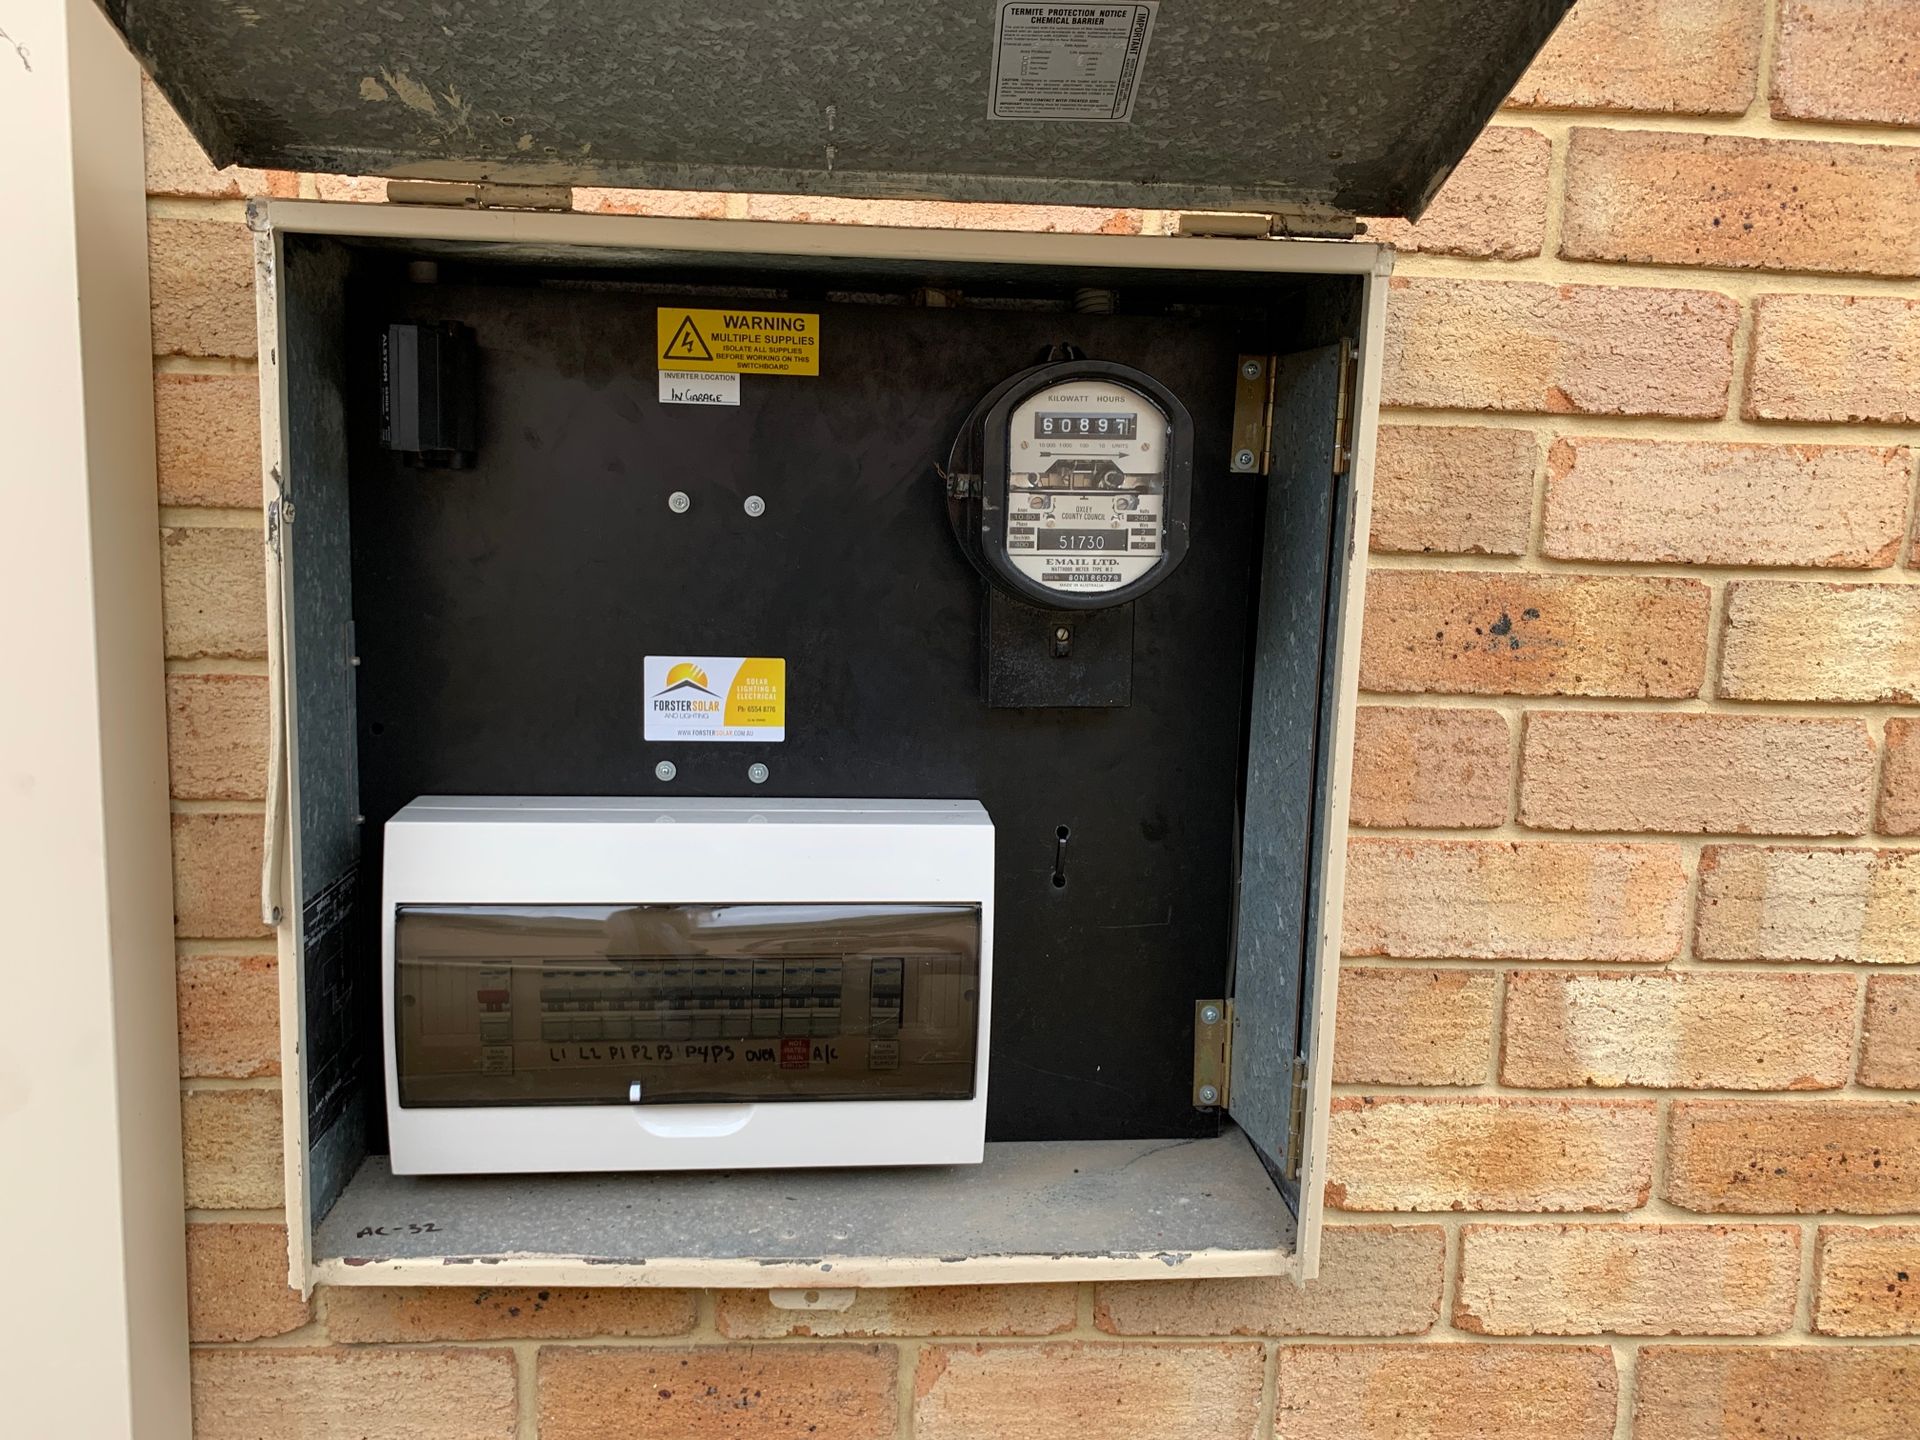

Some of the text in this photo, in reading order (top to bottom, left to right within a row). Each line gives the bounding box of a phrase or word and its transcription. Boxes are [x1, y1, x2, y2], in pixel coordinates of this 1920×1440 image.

[1011, 8, 1128, 18] TERMITE PROTECTION NOTICE
[1030, 17, 1070, 25] CHEMICAL
[1129, 13, 1147, 56] IMPORTANT
[723, 315, 806, 331] WARNING
[711, 333, 815, 345] MULTIPLE SUPPLIES
[746, 354, 780, 362] WORKING
[737, 362, 789, 370] SWITCHBOARD
[664, 372, 700, 380] INVERTER
[1097, 395, 1126, 403] HOURS
[1084, 513, 1106, 521] COUNCIL
[1059, 535, 1105, 550] 51730
[1046, 558, 1089, 566] EMAIL
[579, 1046, 602, 1060] L2
[609, 1046, 625, 1060] P1
[631, 1045, 653, 1061] P2
[657, 1045, 673, 1061] P3
